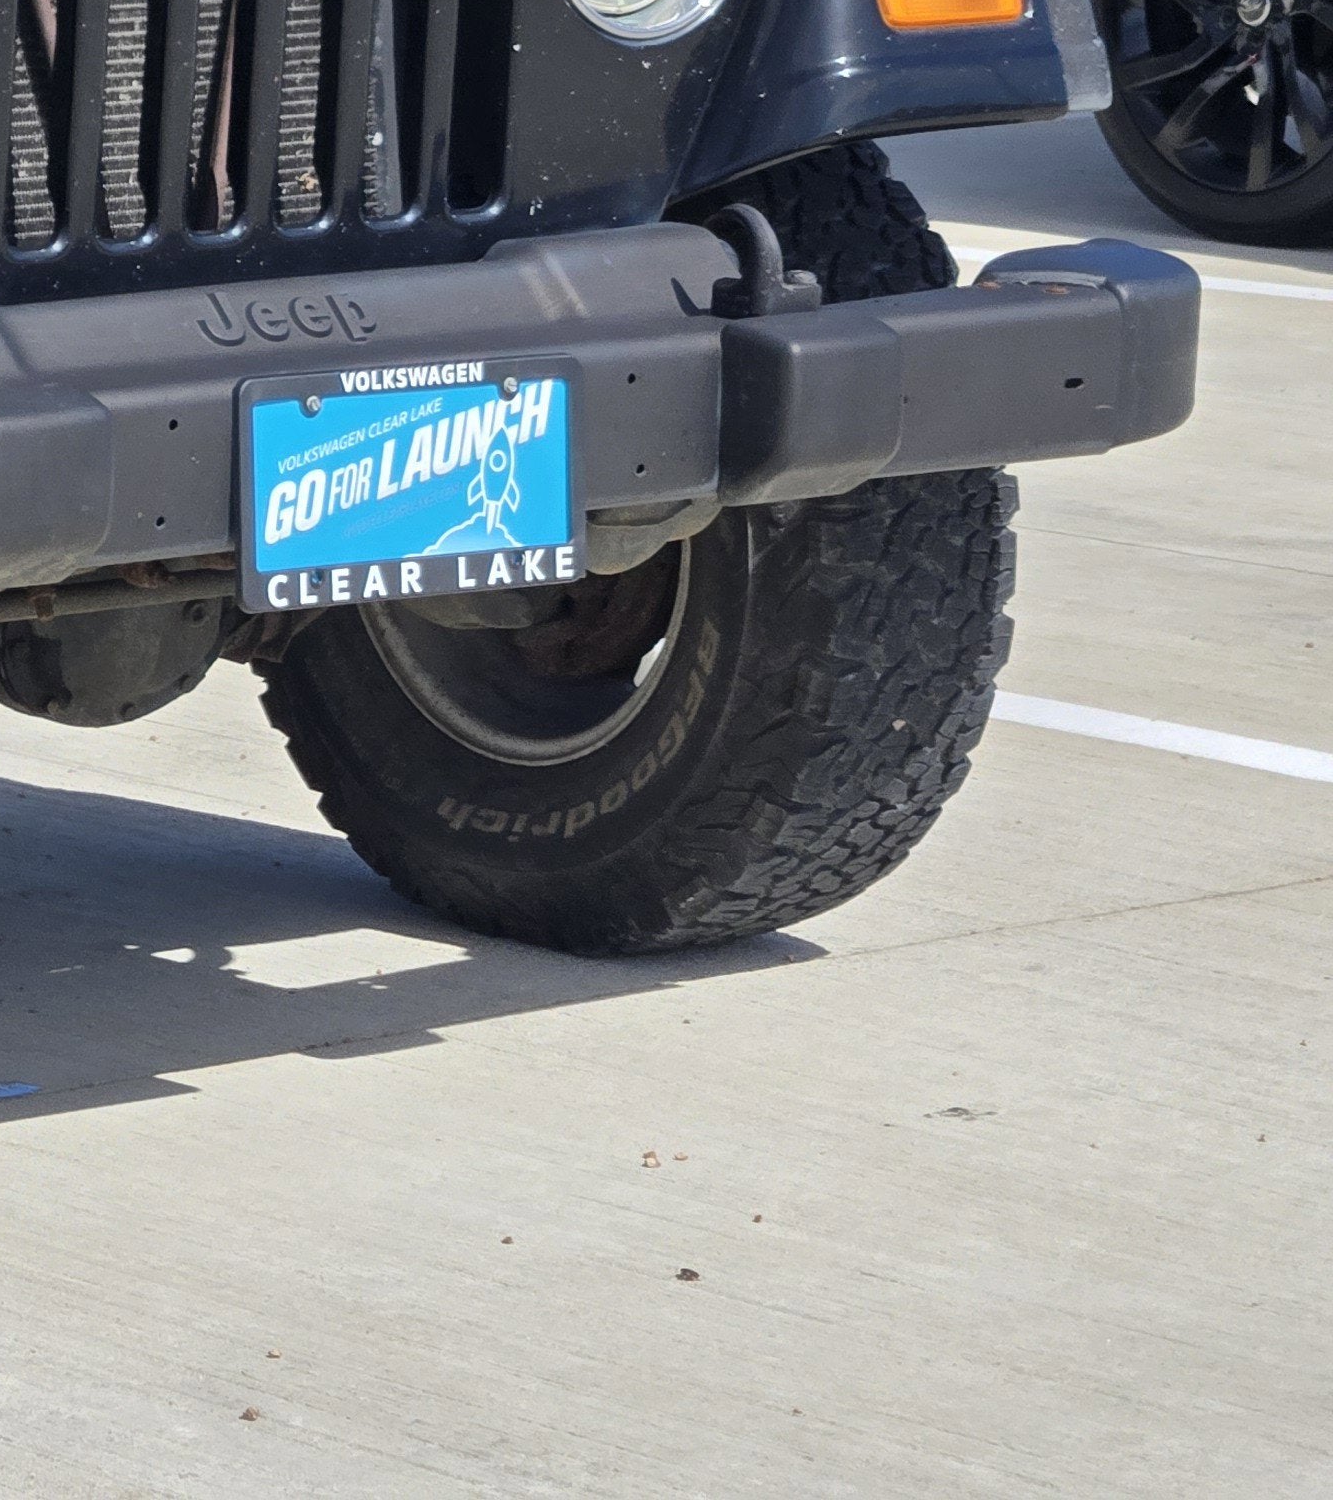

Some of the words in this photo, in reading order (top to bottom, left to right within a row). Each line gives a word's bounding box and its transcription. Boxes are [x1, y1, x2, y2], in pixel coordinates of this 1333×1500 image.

[196, 291, 378, 347] Jeep
[340, 362, 483, 393] VOLKSWAGEN
[264, 468, 327, 545] GO
[327, 456, 374, 516] FOR
[376, 378, 554, 500] LAUNCH
[277, 430, 366, 475] VOLKSWAGEN
[368, 411, 408, 439] CLEAR
[411, 397, 444, 422] LAKE
[267, 561, 423, 608] CLEAR
[457, 545, 575, 588] LAKE
